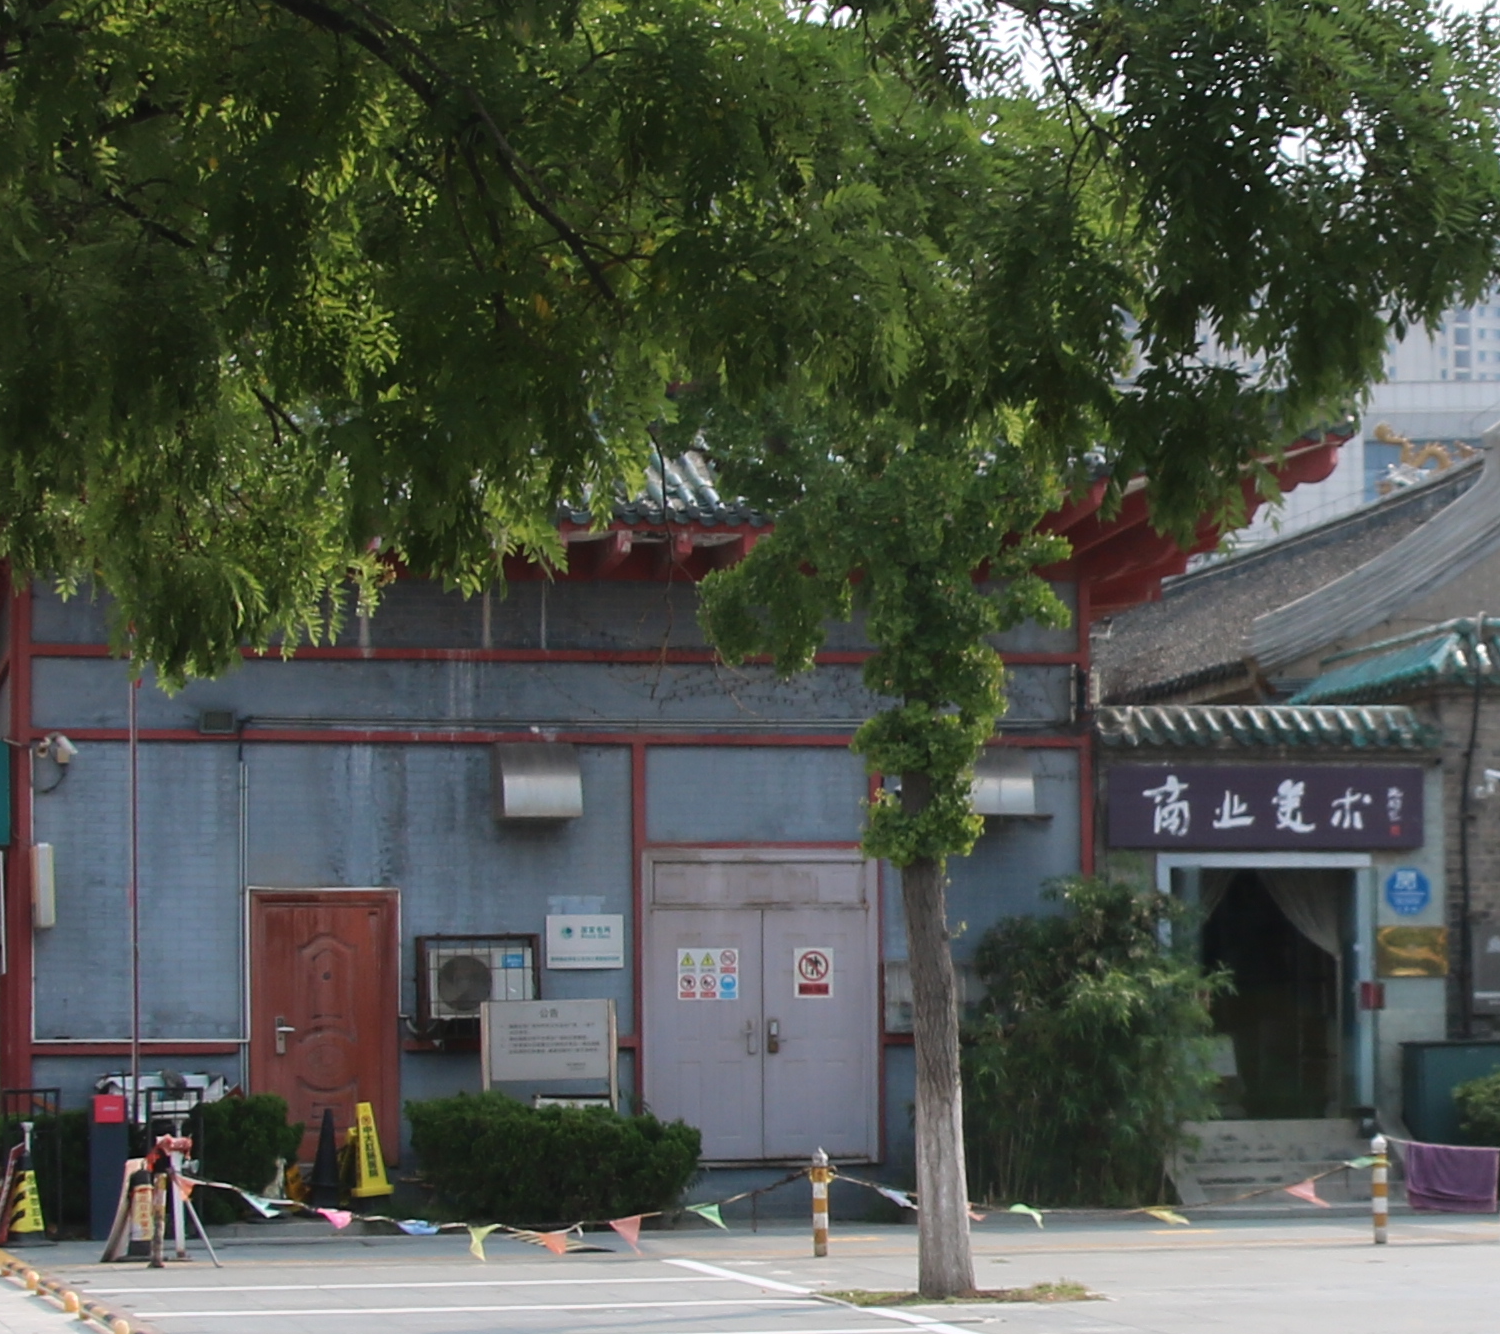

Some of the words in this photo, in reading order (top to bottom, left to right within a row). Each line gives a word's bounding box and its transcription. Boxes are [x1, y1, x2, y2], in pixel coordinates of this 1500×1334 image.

[1143, 775, 1372, 836] 商业美术
[539, 1007, 559, 1018] 公告
